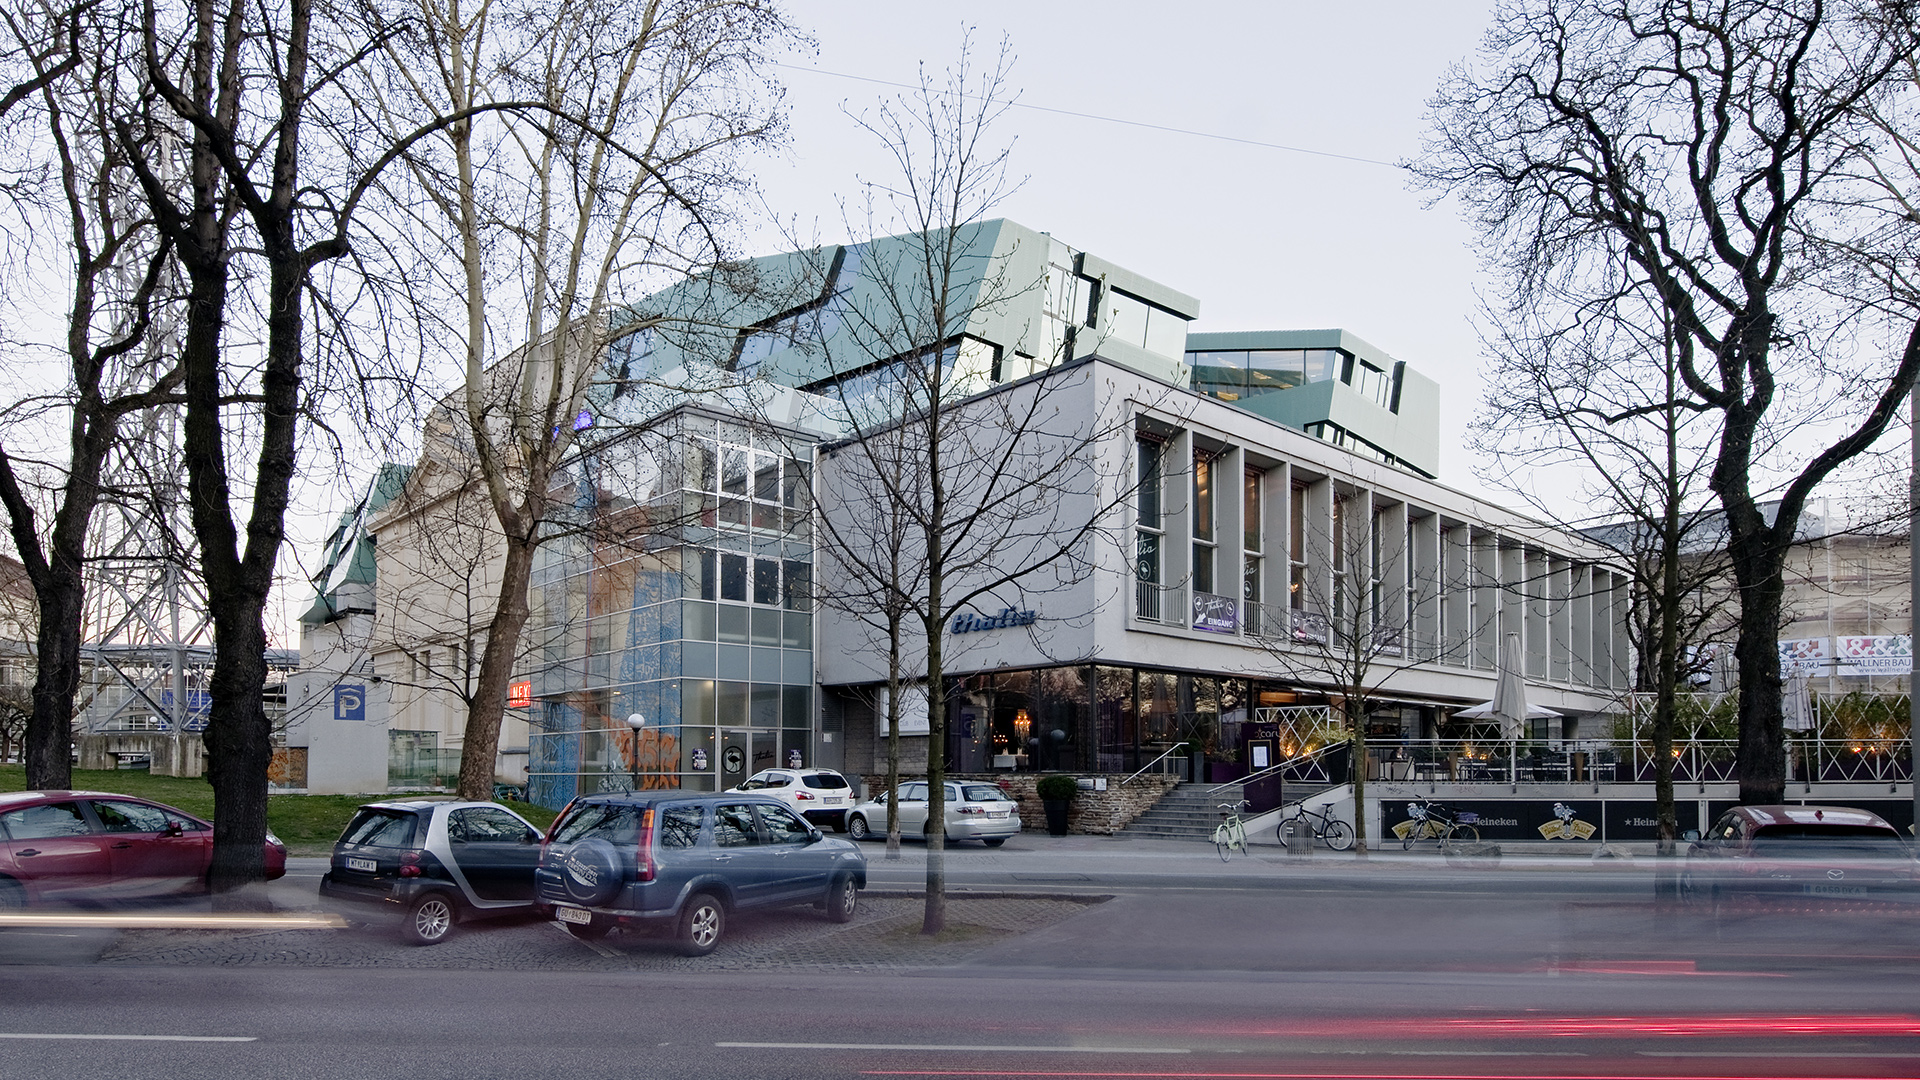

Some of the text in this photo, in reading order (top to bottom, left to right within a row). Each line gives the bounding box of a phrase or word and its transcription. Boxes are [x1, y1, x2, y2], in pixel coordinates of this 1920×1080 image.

[1207, 618, 1233, 628] EINGANG
[1846, 658, 1911, 667] WALLNER BAU
[340, 695, 361, 718] P
[1473, 817, 1518, 826] Heineken
[1633, 817, 1679, 827] Heinen
[567, 860, 598, 885] HONDA
